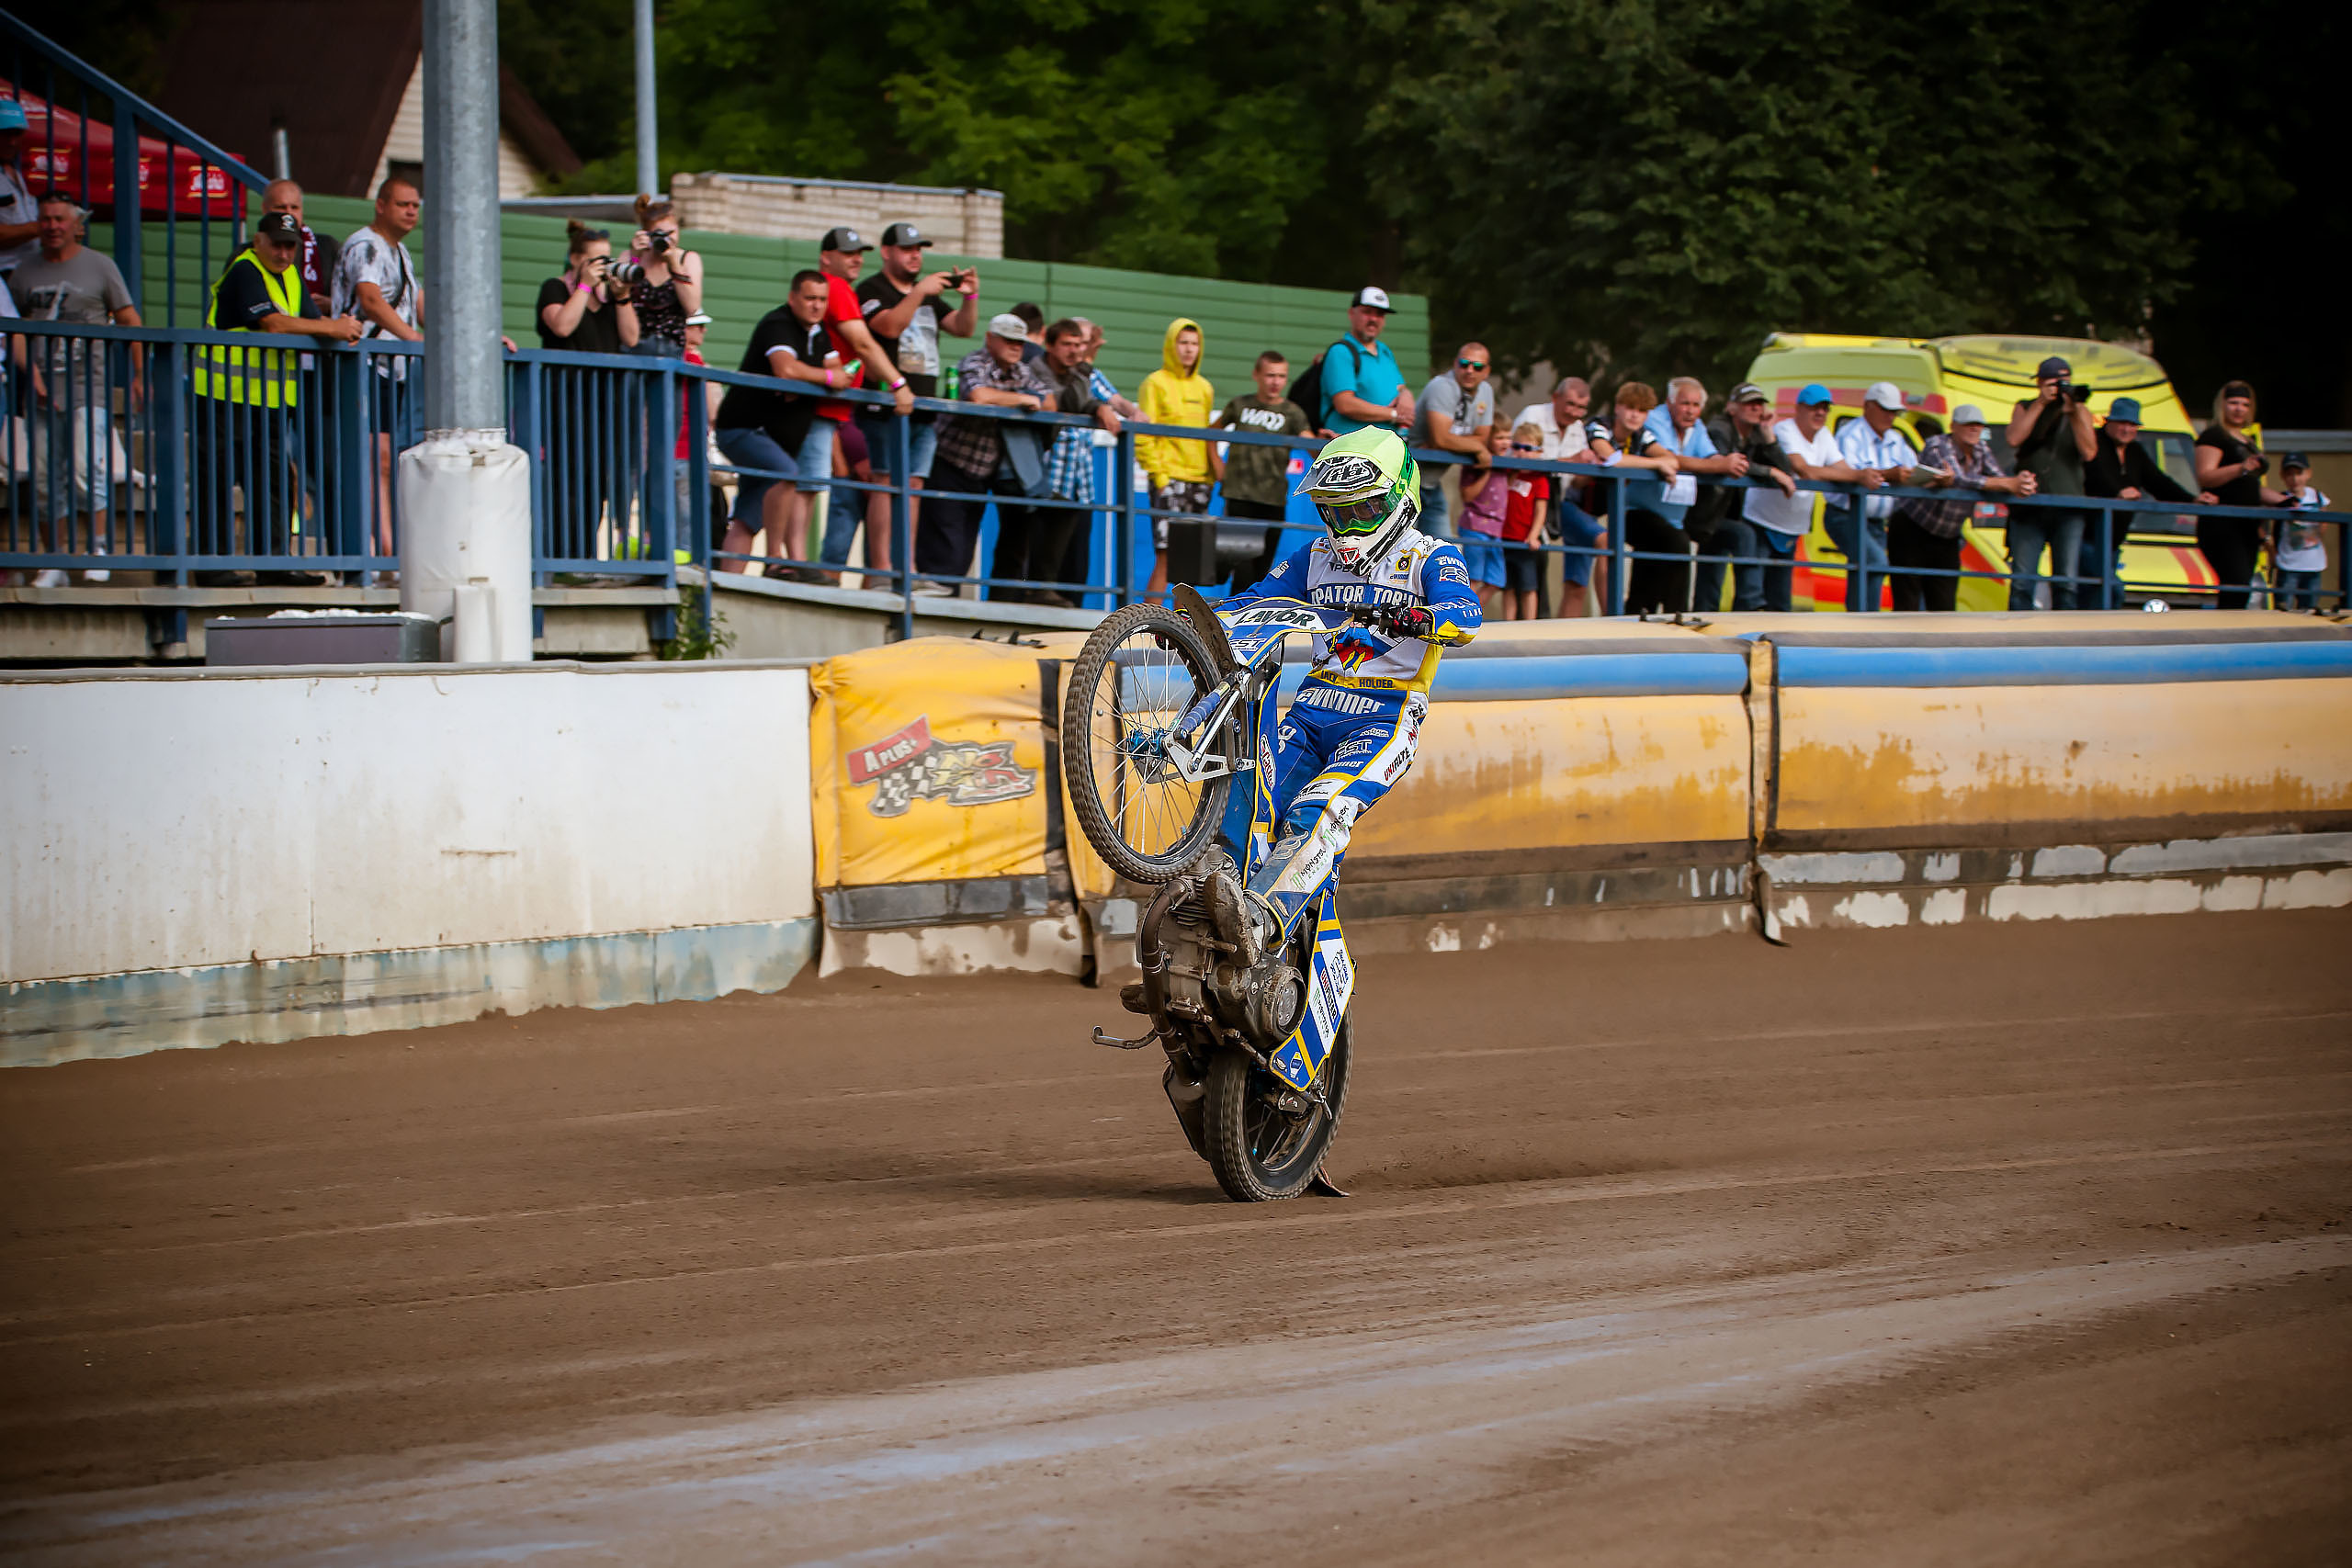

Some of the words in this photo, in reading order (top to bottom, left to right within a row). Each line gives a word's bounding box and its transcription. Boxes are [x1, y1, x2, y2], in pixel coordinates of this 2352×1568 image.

[1234, 610, 1316, 626] LAVOR
[1360, 678, 1394, 689] HOLDER
[1384, 746, 1411, 782] UNIFILTE
[1321, 970, 1338, 1020] UNIFILTER
